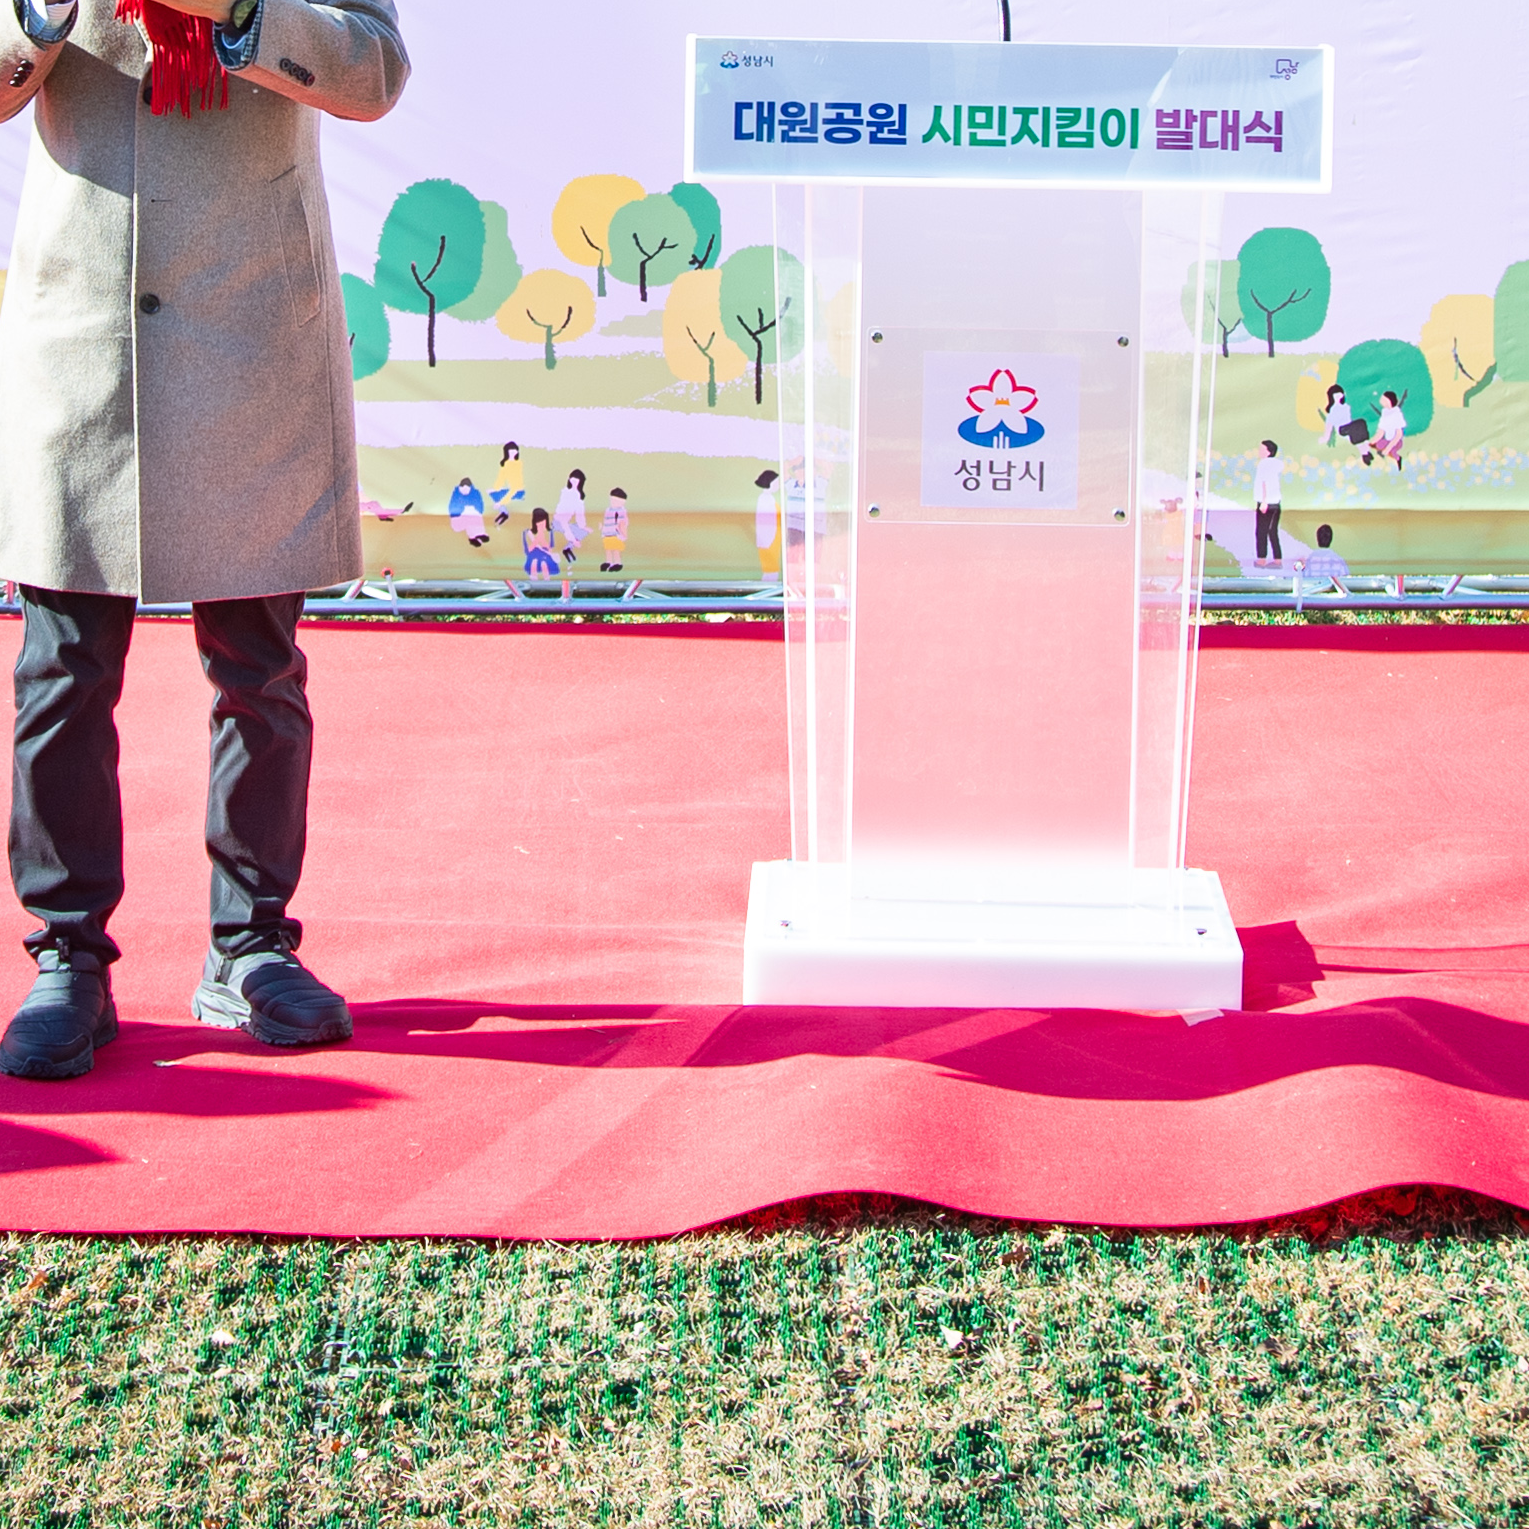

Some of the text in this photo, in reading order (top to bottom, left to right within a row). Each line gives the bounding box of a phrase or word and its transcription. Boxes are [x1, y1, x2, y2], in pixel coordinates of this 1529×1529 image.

[741, 55, 774, 68] 성남시
[733, 100, 1284, 153] 대원공원 시민지킴이 발대식
[953, 458, 1045, 492] 성남시
